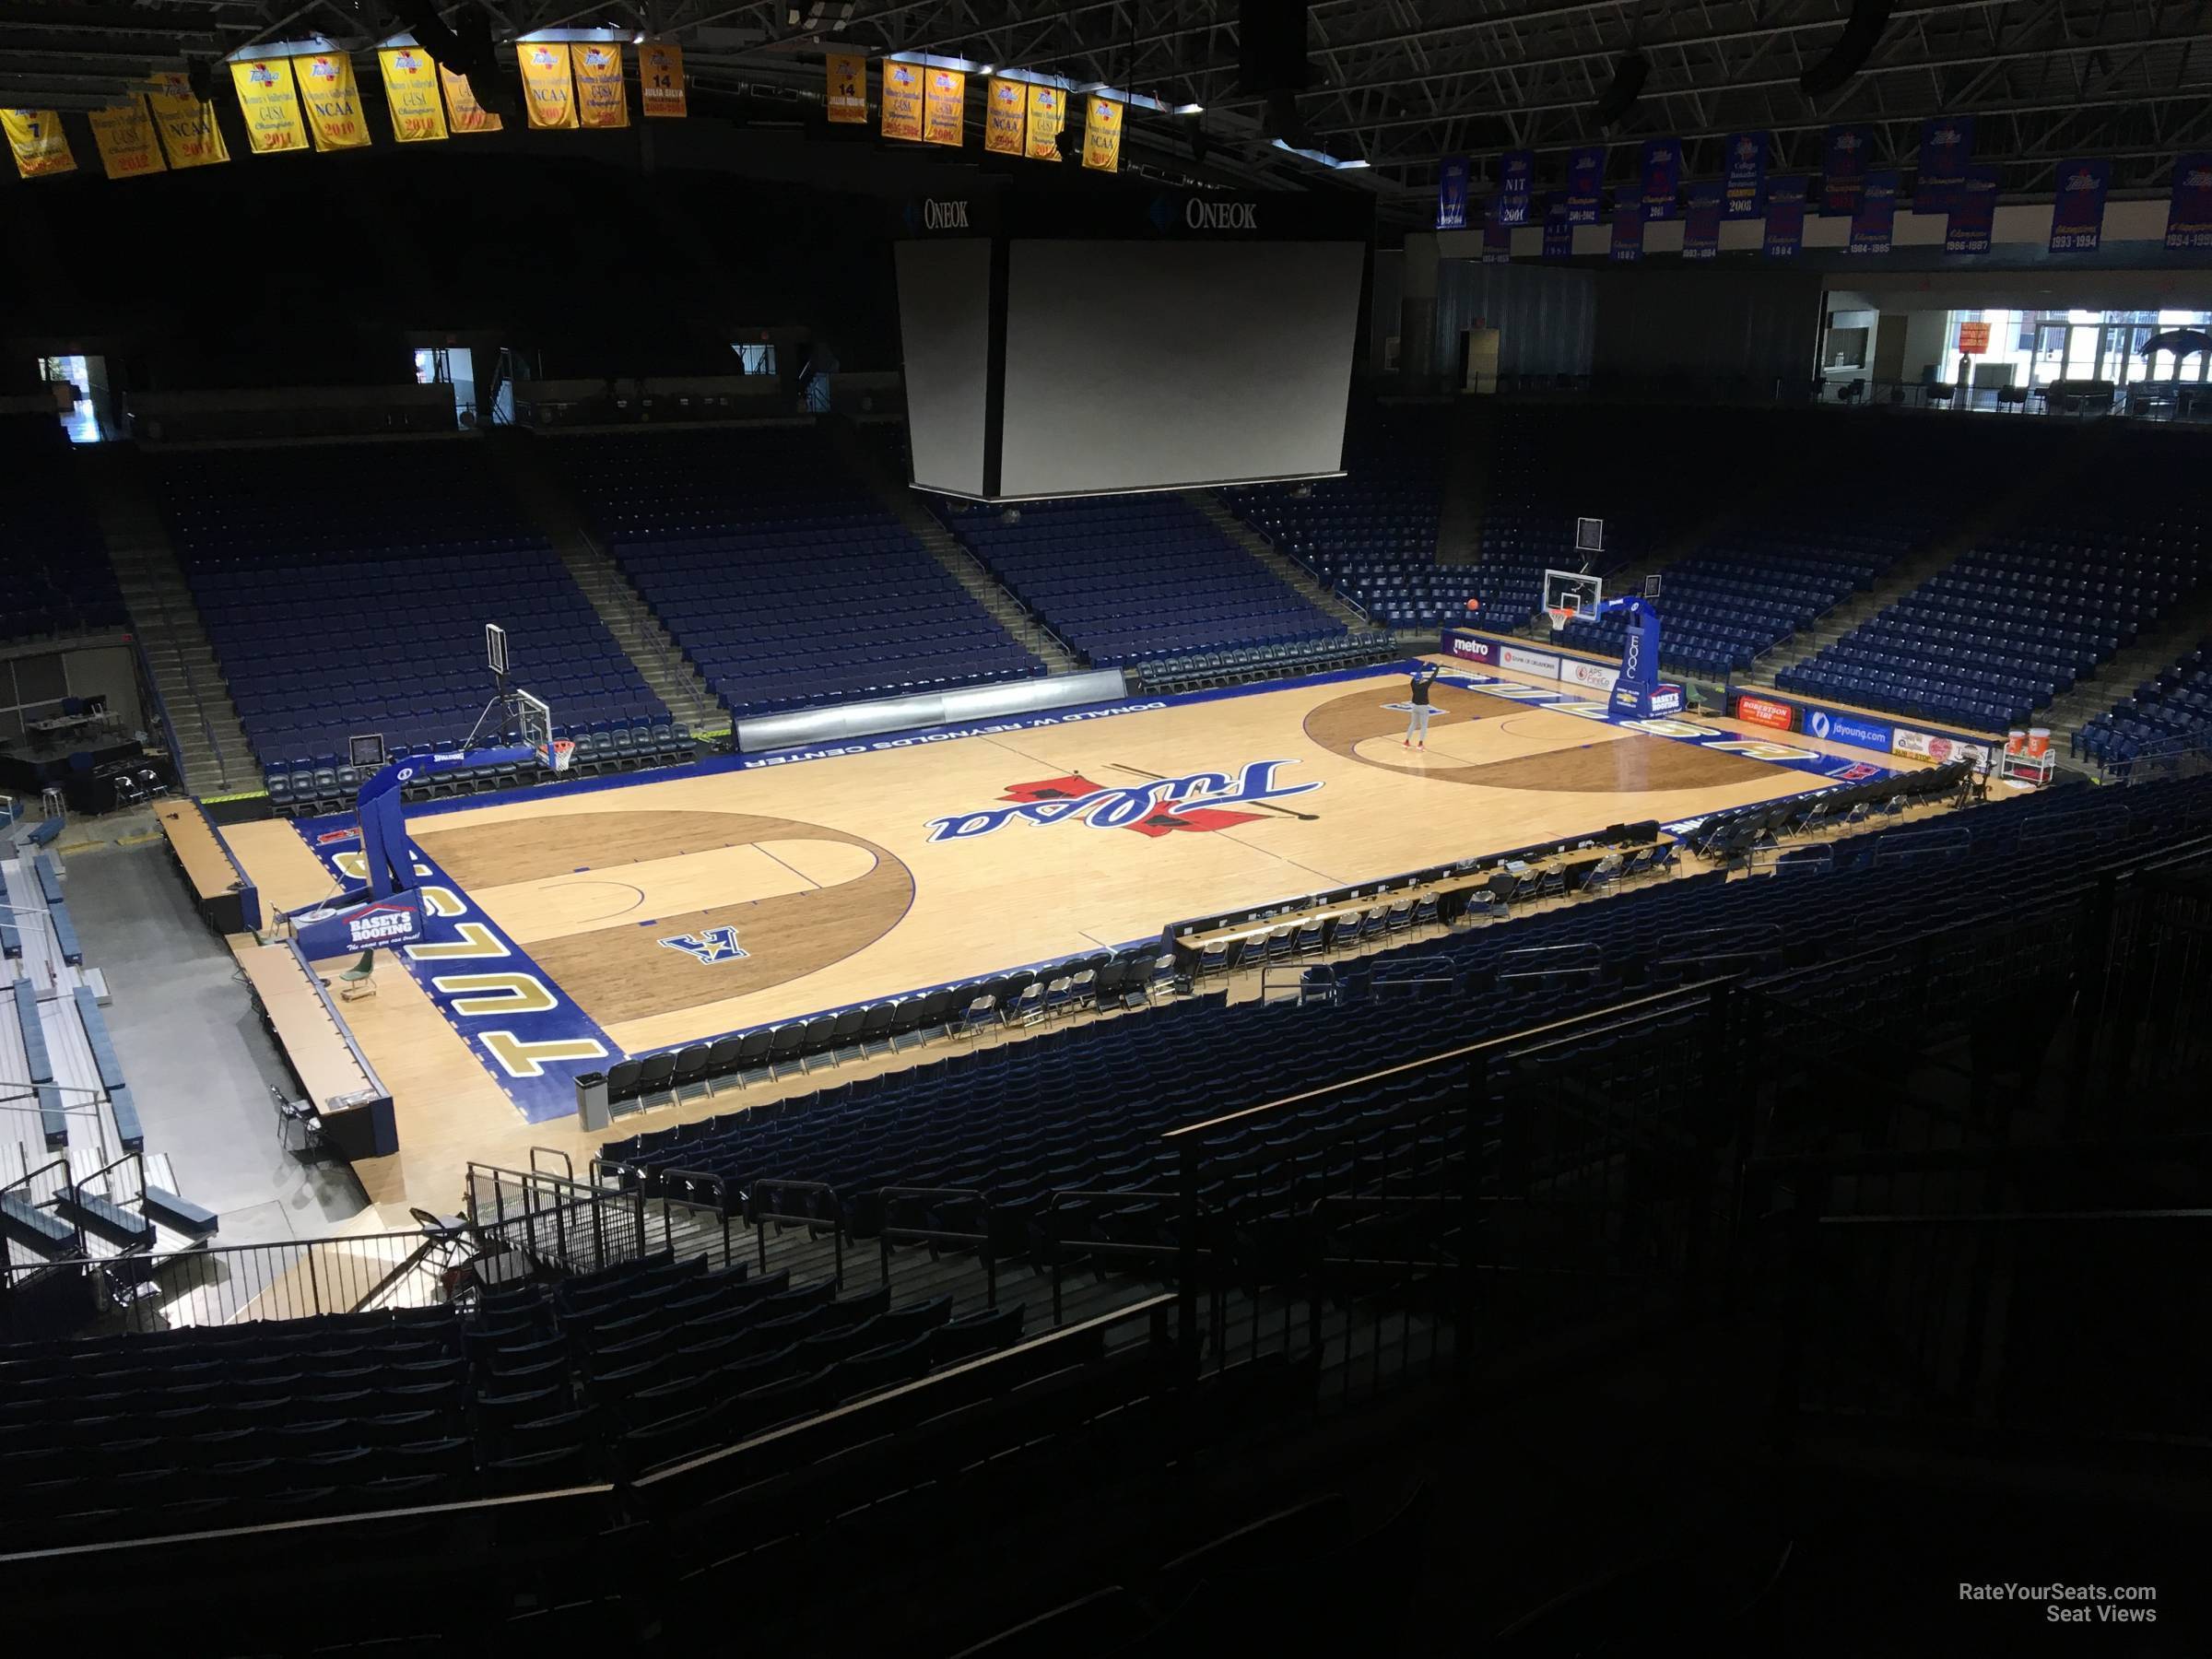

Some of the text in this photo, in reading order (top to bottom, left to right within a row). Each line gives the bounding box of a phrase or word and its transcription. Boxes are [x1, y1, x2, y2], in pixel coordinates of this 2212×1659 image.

[394, 56, 424, 70] Tulsa
[249, 67, 280, 84] Tulsa
[311, 64, 342, 78] Tulsa
[653, 74, 672, 88] 14
[532, 88, 569, 102] NCAA
[839, 83, 855, 97] 14
[314, 102, 355, 118] NCAA
[29, 123, 40, 138] 7
[170, 122, 212, 138] NCAA
[324, 121, 355, 136] 2010
[405, 117, 435, 132] 2010
[993, 118, 1019, 133] NCAA
[263, 132, 294, 147] 2011
[1090, 135, 1114, 150] NCAA
[1504, 178, 1526, 192] NIT
[924, 198, 969, 229] ONEOK
[1186, 197, 1257, 229] ONEOK
[1728, 199, 1753, 213] 2008
[1503, 208, 1524, 222] 2001
[1850, 243, 1891, 253] 1984-1985
[1947, 241, 1989, 252] 1986-1987
[2052, 234, 2098, 249] 1993-1994
[1454, 639, 1488, 655] metro
[1588, 667, 1603, 677] APS
[1587, 675, 1610, 688] FireCo
[1743, 700, 1788, 716] ROBERTSON
[1756, 709, 1774, 720] TIRE
[744, 700, 1168, 770] DONALD W. REYNOLDS CENTER
[1832, 723, 1886, 743] jdyoung.com
[924, 759, 1325, 842] Tulsa
[349, 911, 411, 932] BASEY'S
[351, 922, 413, 942] ROOFING
